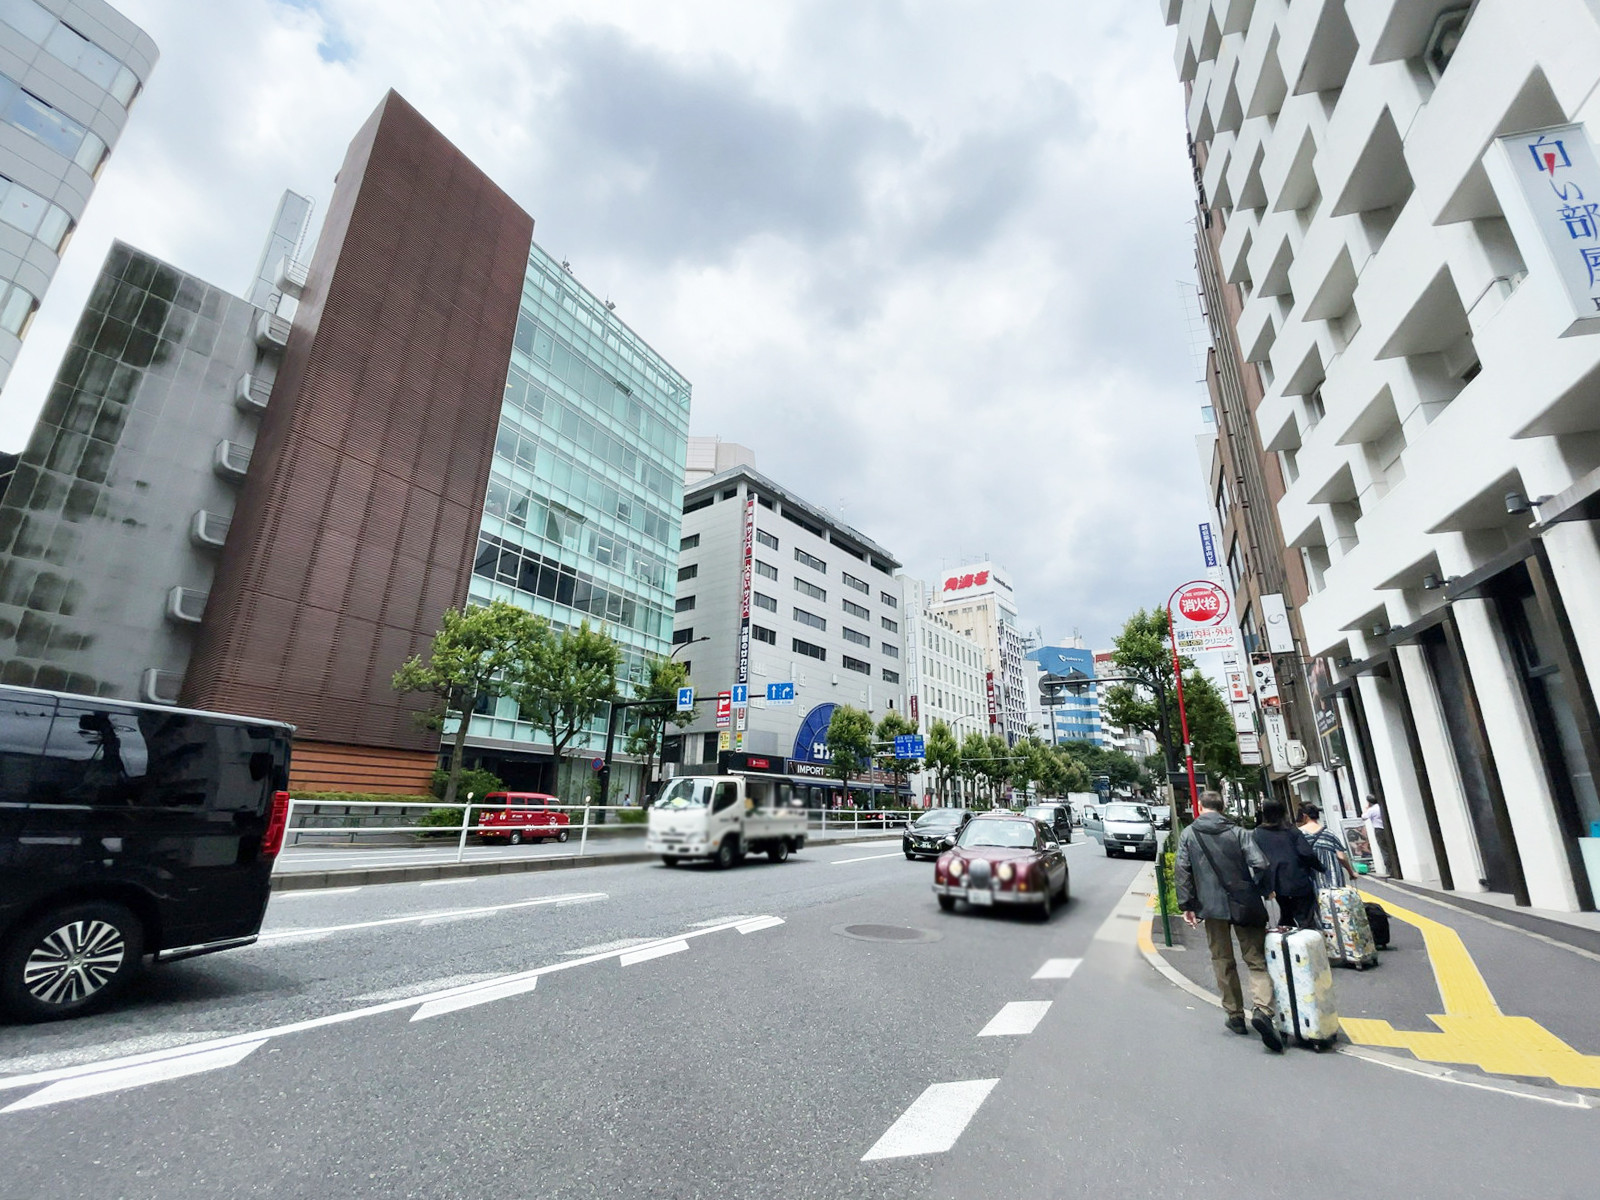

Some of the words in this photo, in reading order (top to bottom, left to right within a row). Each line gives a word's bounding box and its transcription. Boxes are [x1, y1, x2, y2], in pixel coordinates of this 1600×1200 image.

[1181, 596, 1218, 612] 消火栓
[1204, 637, 1234, 645] クリニック
[797, 764, 824, 776] IMPORT
